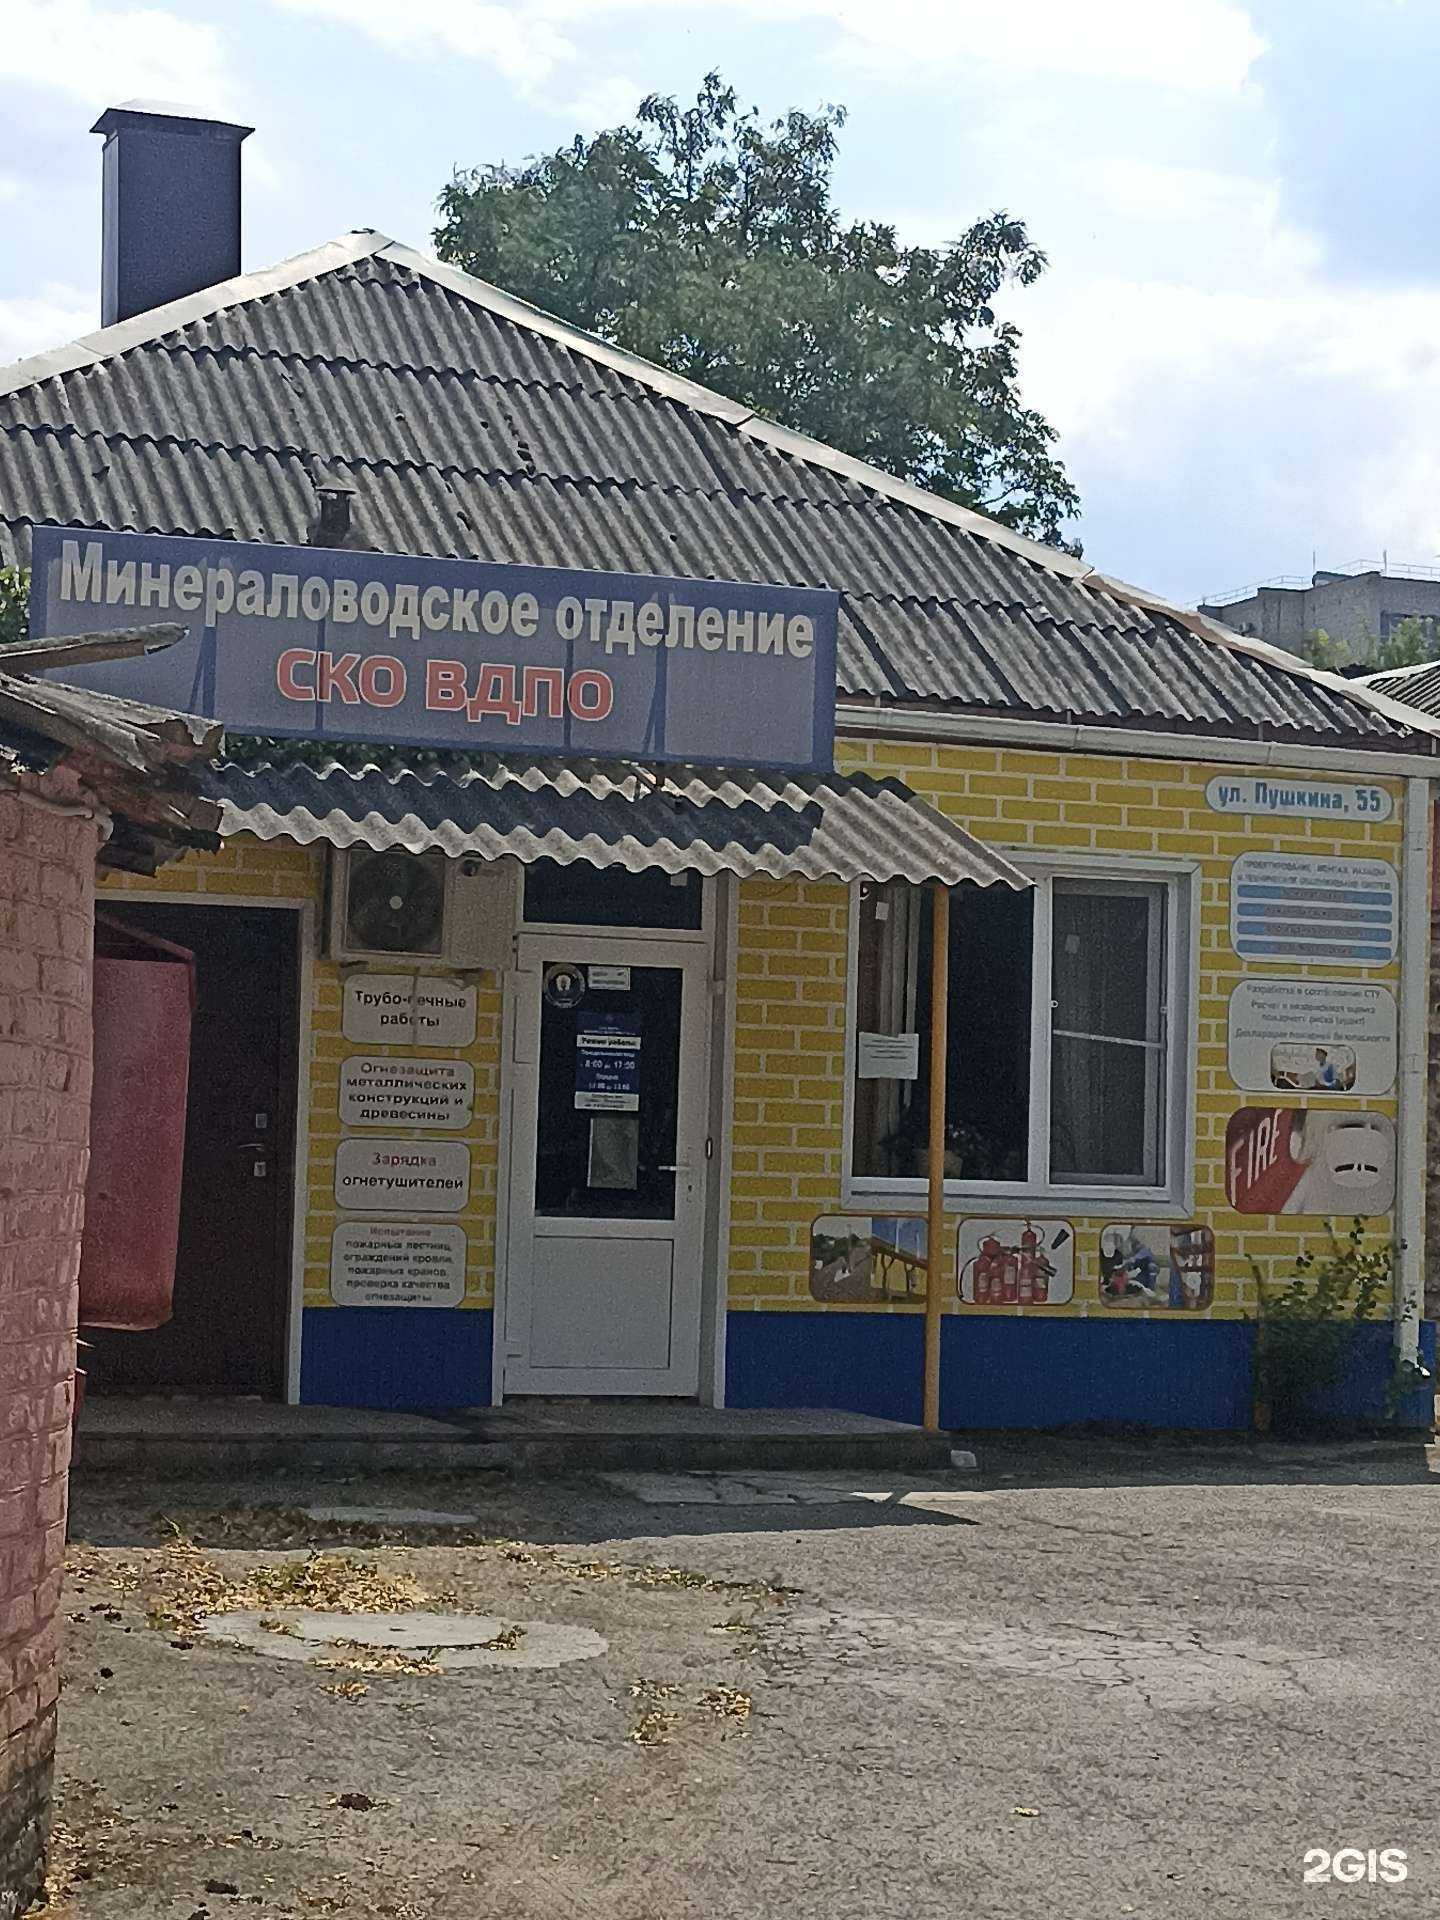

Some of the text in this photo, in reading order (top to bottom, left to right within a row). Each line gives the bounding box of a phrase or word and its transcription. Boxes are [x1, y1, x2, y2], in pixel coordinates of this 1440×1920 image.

[60, 540, 814, 658] Минераловодское отделение
[277, 648, 613, 725] СКО ВДПО
[1218, 782, 1381, 813] ул. Пушкина, 55
[361, 1062, 454, 1077] Огнезащита
[347, 1079, 467, 1091] металлических
[349, 1092, 463, 1106] конструкций и
[360, 1108, 450, 1121] древесины
[372, 1152, 437, 1168] Зарядка
[1230, 1108, 1283, 1206] FIRE
[342, 1175, 463, 1190] огнетушителей
